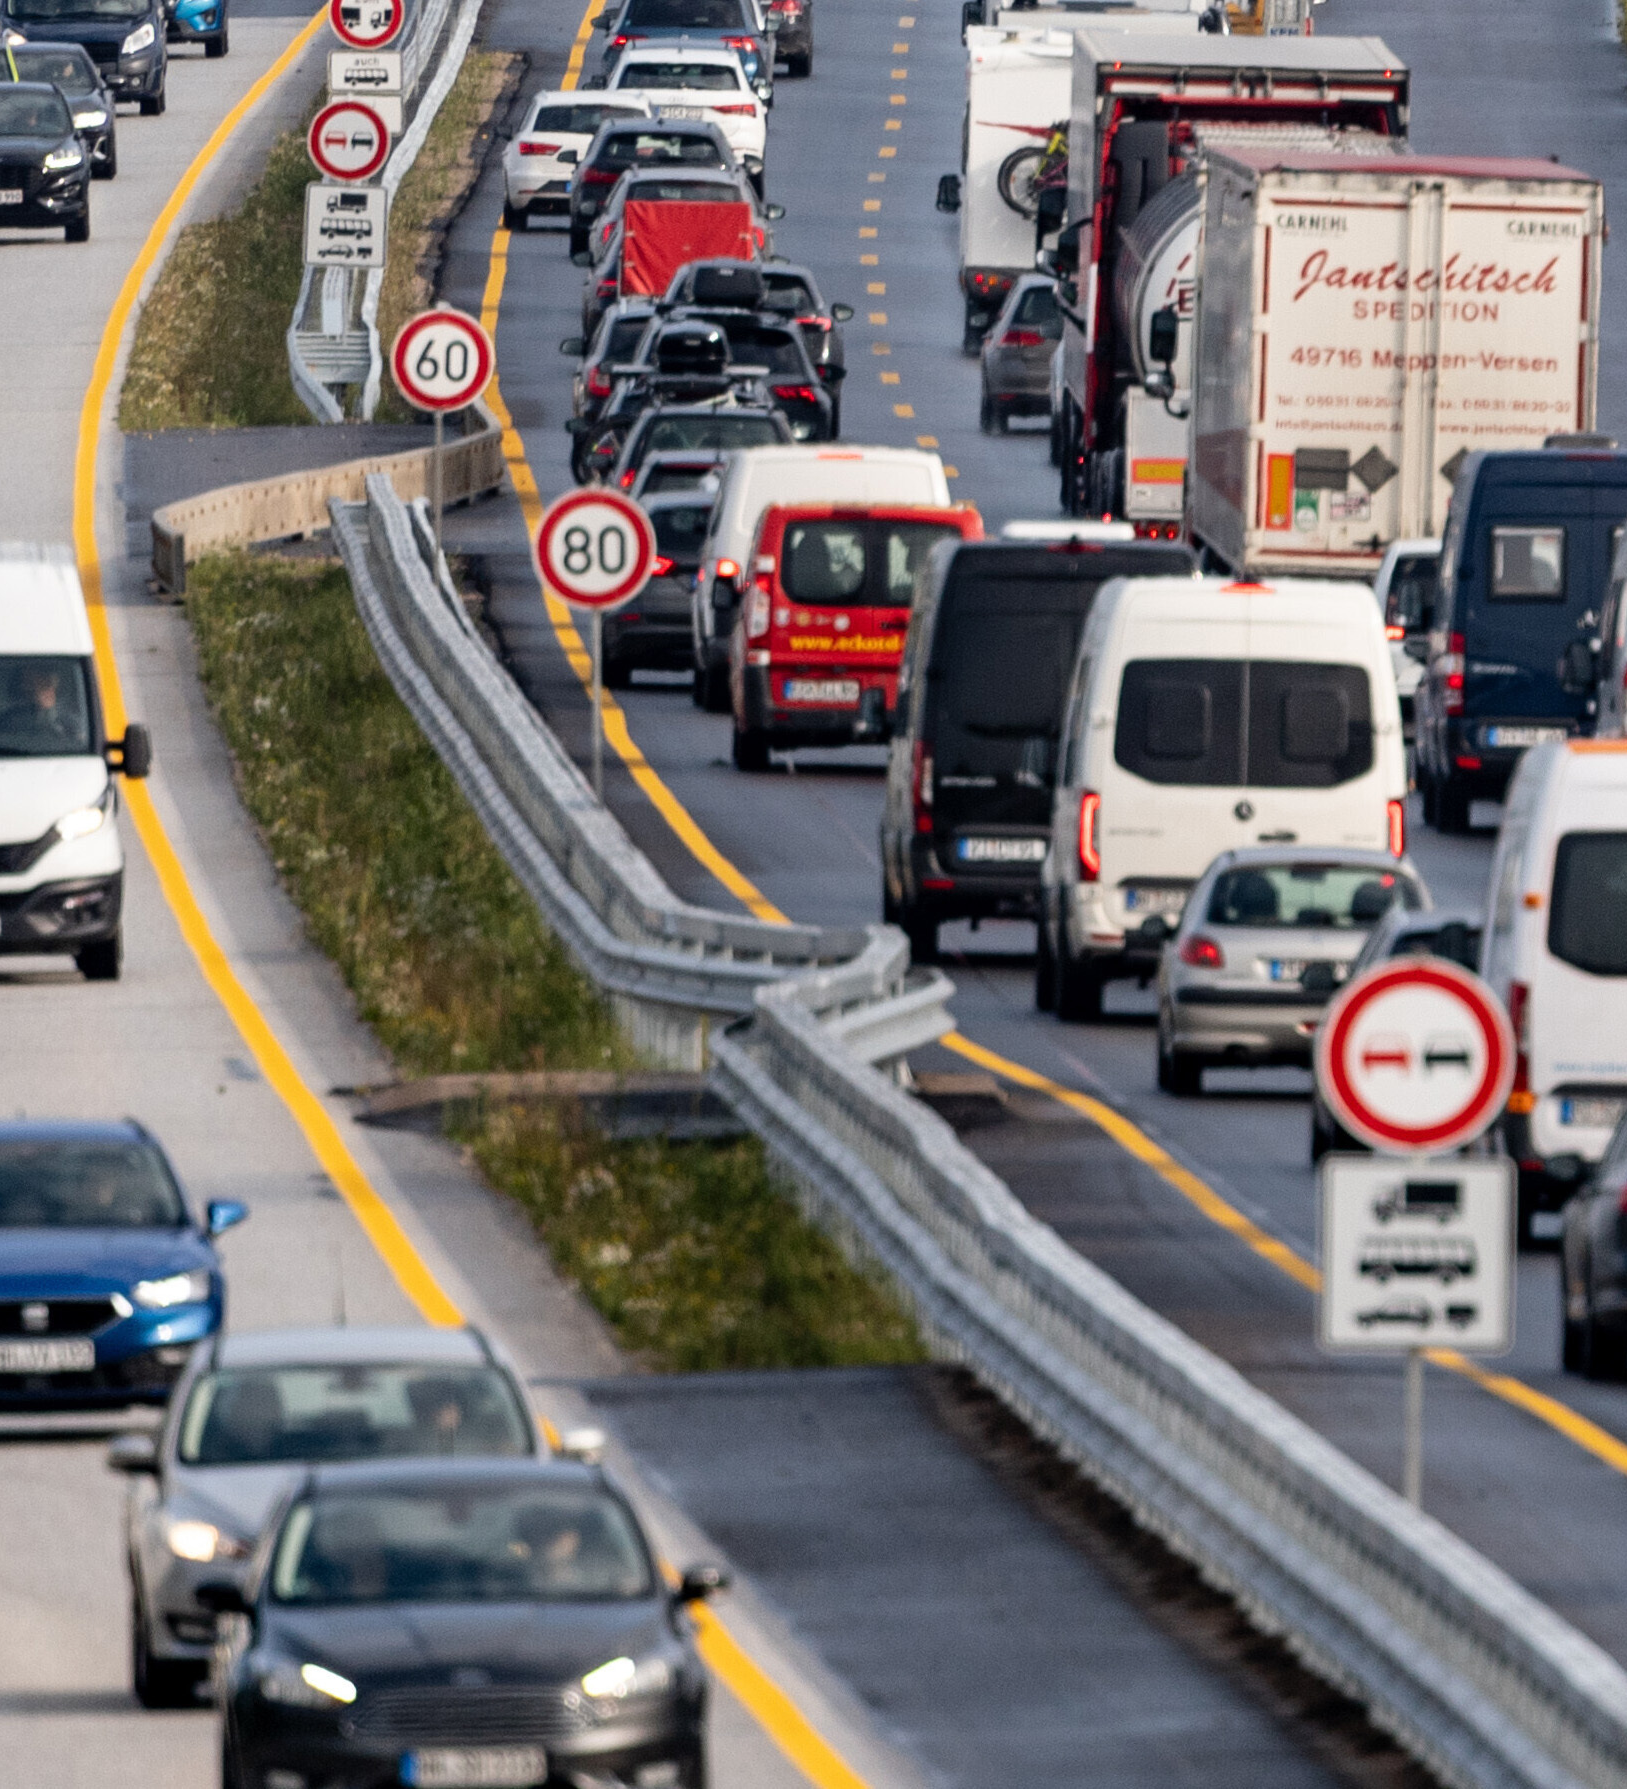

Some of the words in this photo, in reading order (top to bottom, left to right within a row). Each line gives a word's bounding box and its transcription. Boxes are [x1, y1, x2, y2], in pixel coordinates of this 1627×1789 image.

[355, 57, 380, 66] auch
[1276, 213, 1347, 232] CARNEHL
[1293, 249, 1559, 302] Jantschitsch
[1353, 300, 1500, 322] SPEDITION
[416, 339, 469, 382] 60
[1291, 346, 1363, 368] 49716
[1372, 349, 1559, 374] Meppen-Versen
[563, 526, 625, 574] 80
